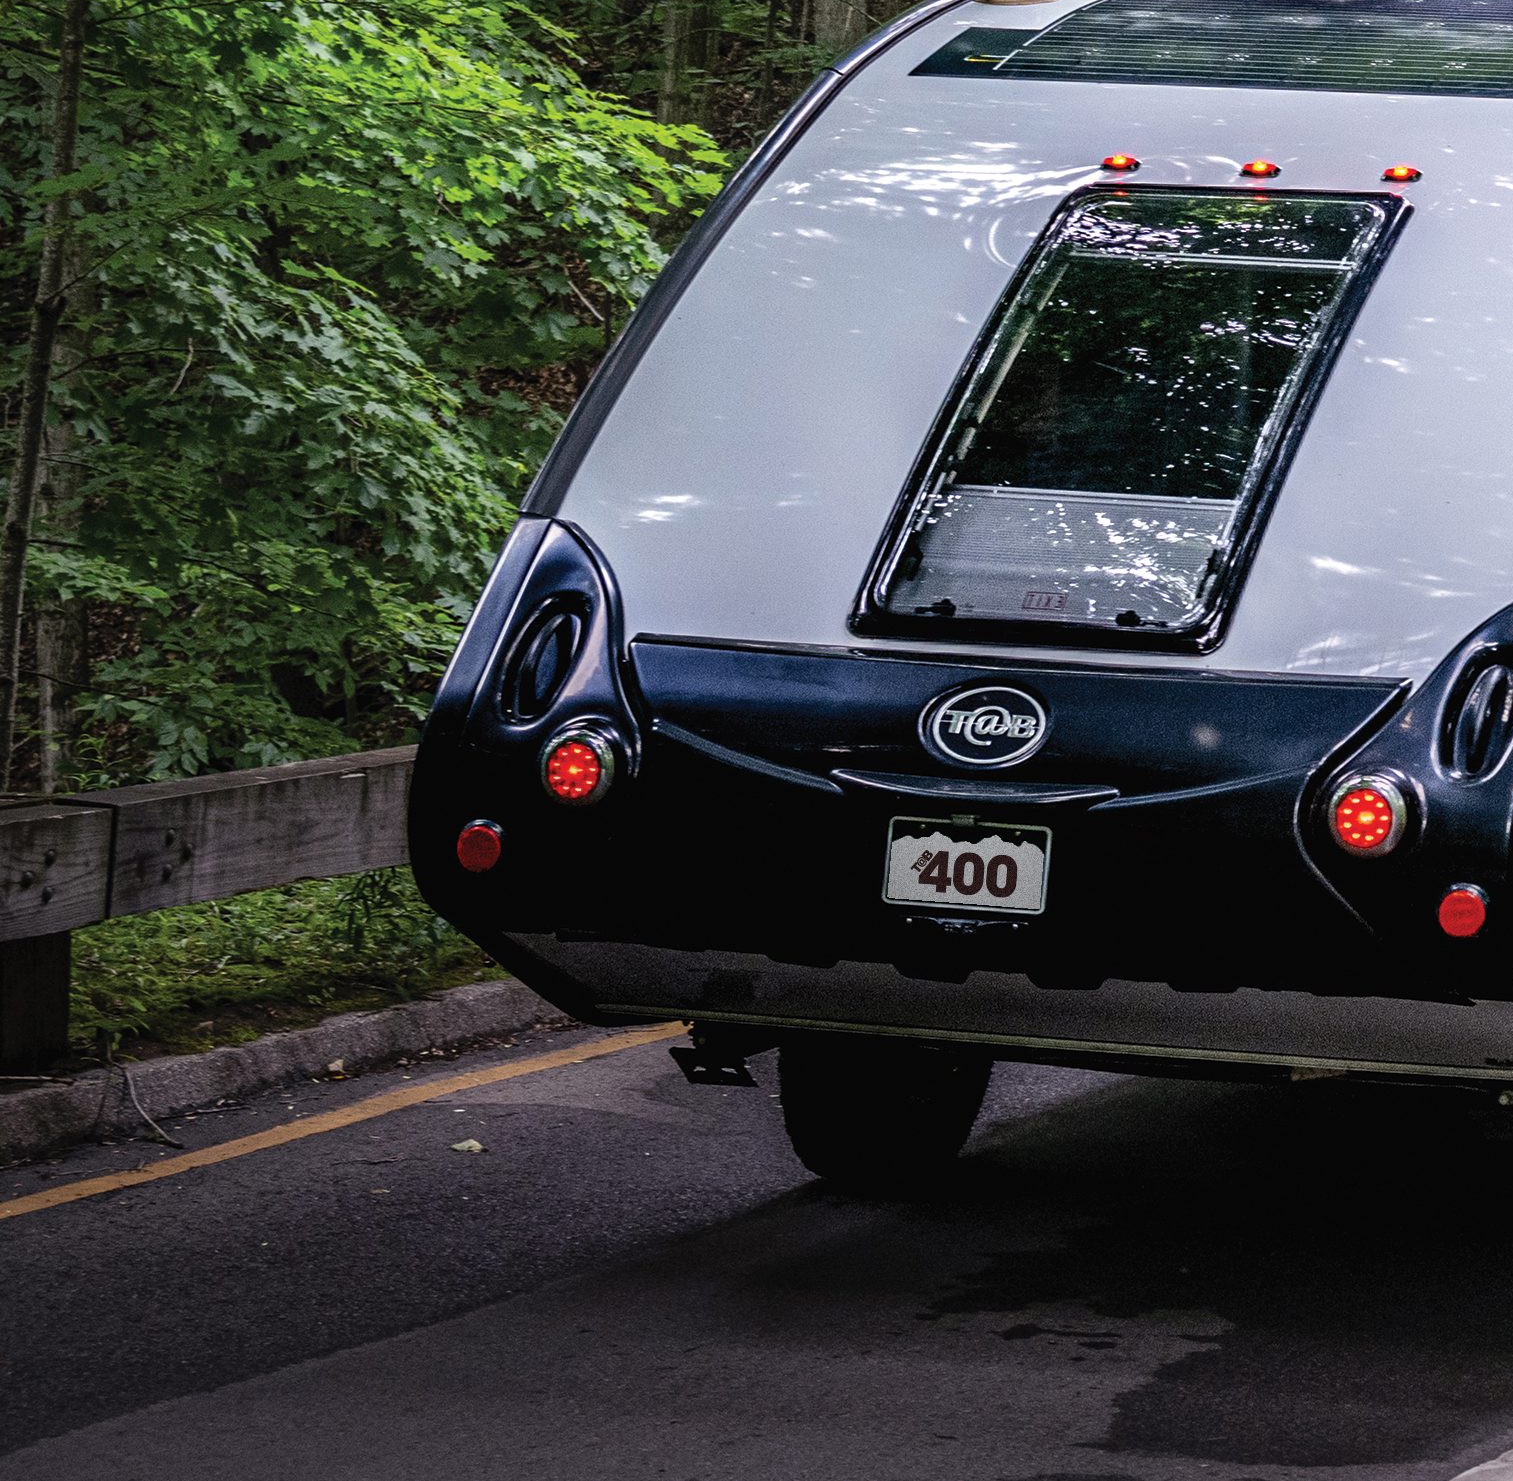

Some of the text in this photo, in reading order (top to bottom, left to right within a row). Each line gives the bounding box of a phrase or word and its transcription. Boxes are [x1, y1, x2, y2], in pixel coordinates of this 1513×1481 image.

[946, 705, 1037, 746] T@B
[911, 850, 934, 872] T@B
[918, 851, 1018, 898] 400
